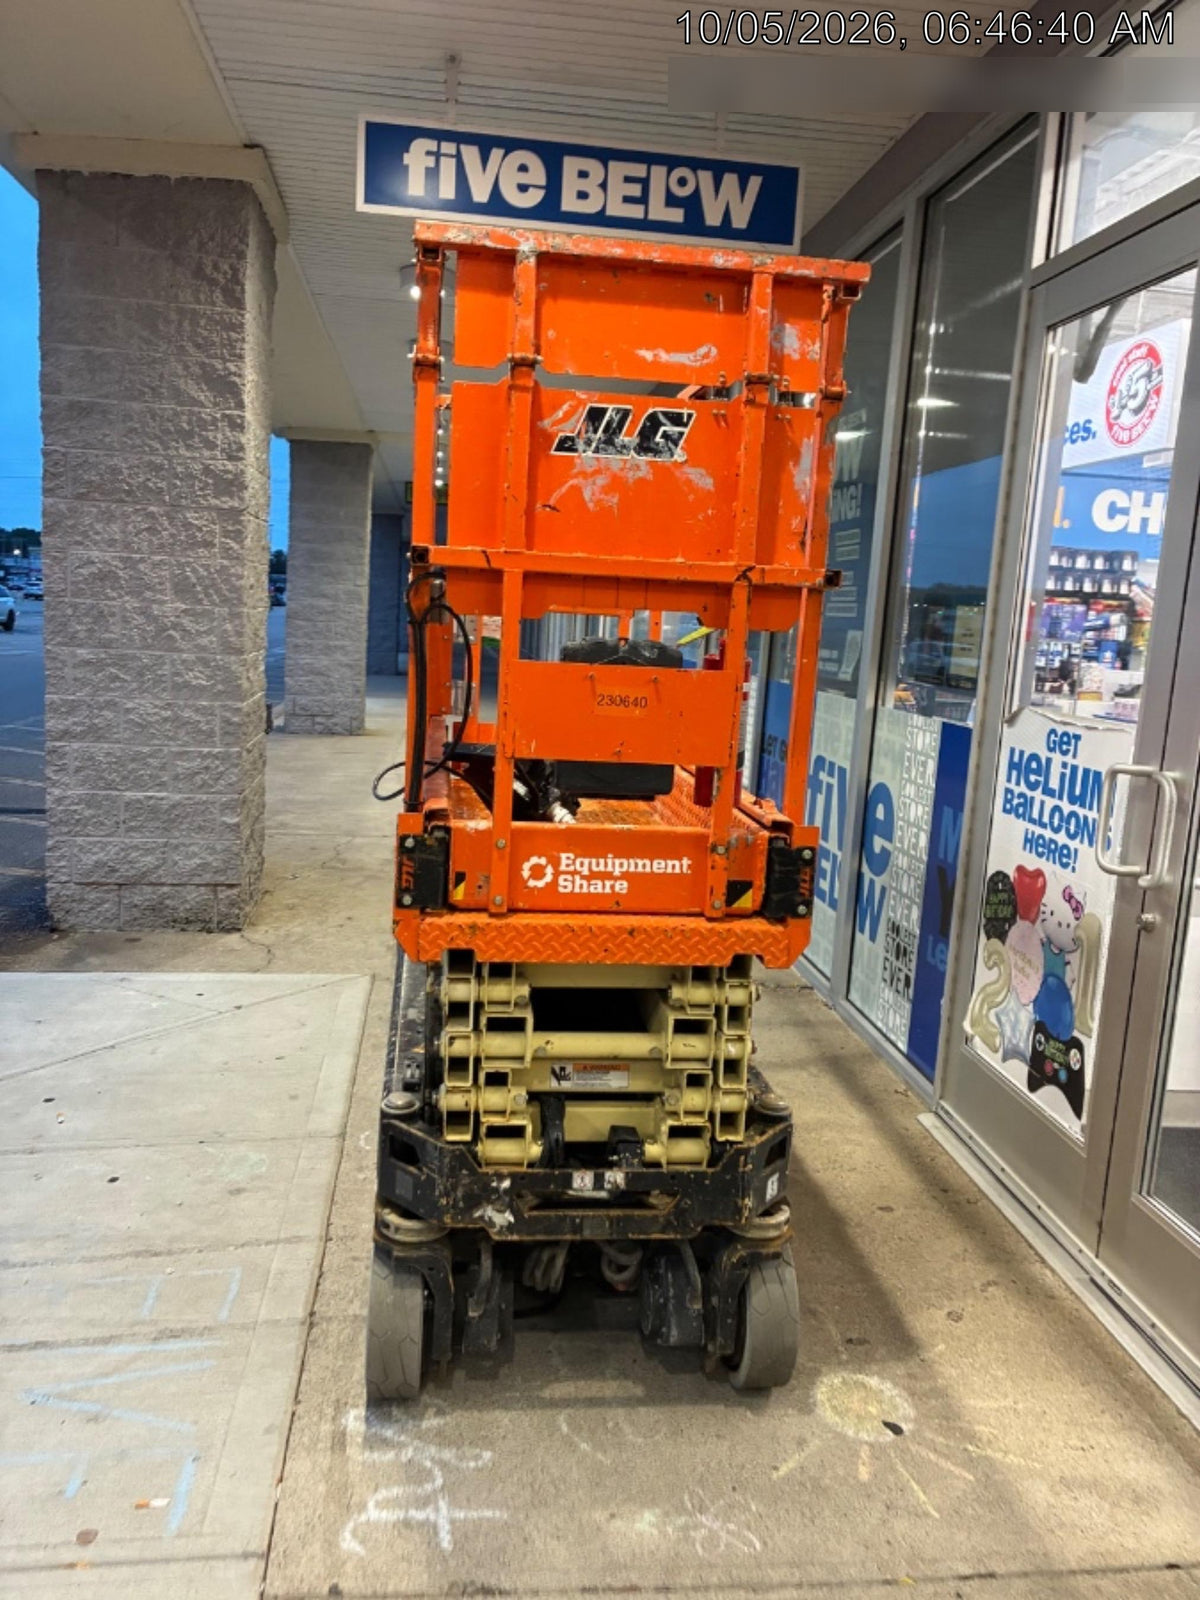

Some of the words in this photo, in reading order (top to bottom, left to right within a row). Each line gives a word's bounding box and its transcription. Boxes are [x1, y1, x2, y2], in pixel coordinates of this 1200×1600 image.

[560, 156, 763, 229] BELOW
[550, 403, 697, 461] JLG
[1091, 488, 1167, 535] CH
[596, 693, 649, 709] 230640
[558, 852, 692, 877] Equipment
[558, 874, 629, 894] Share
